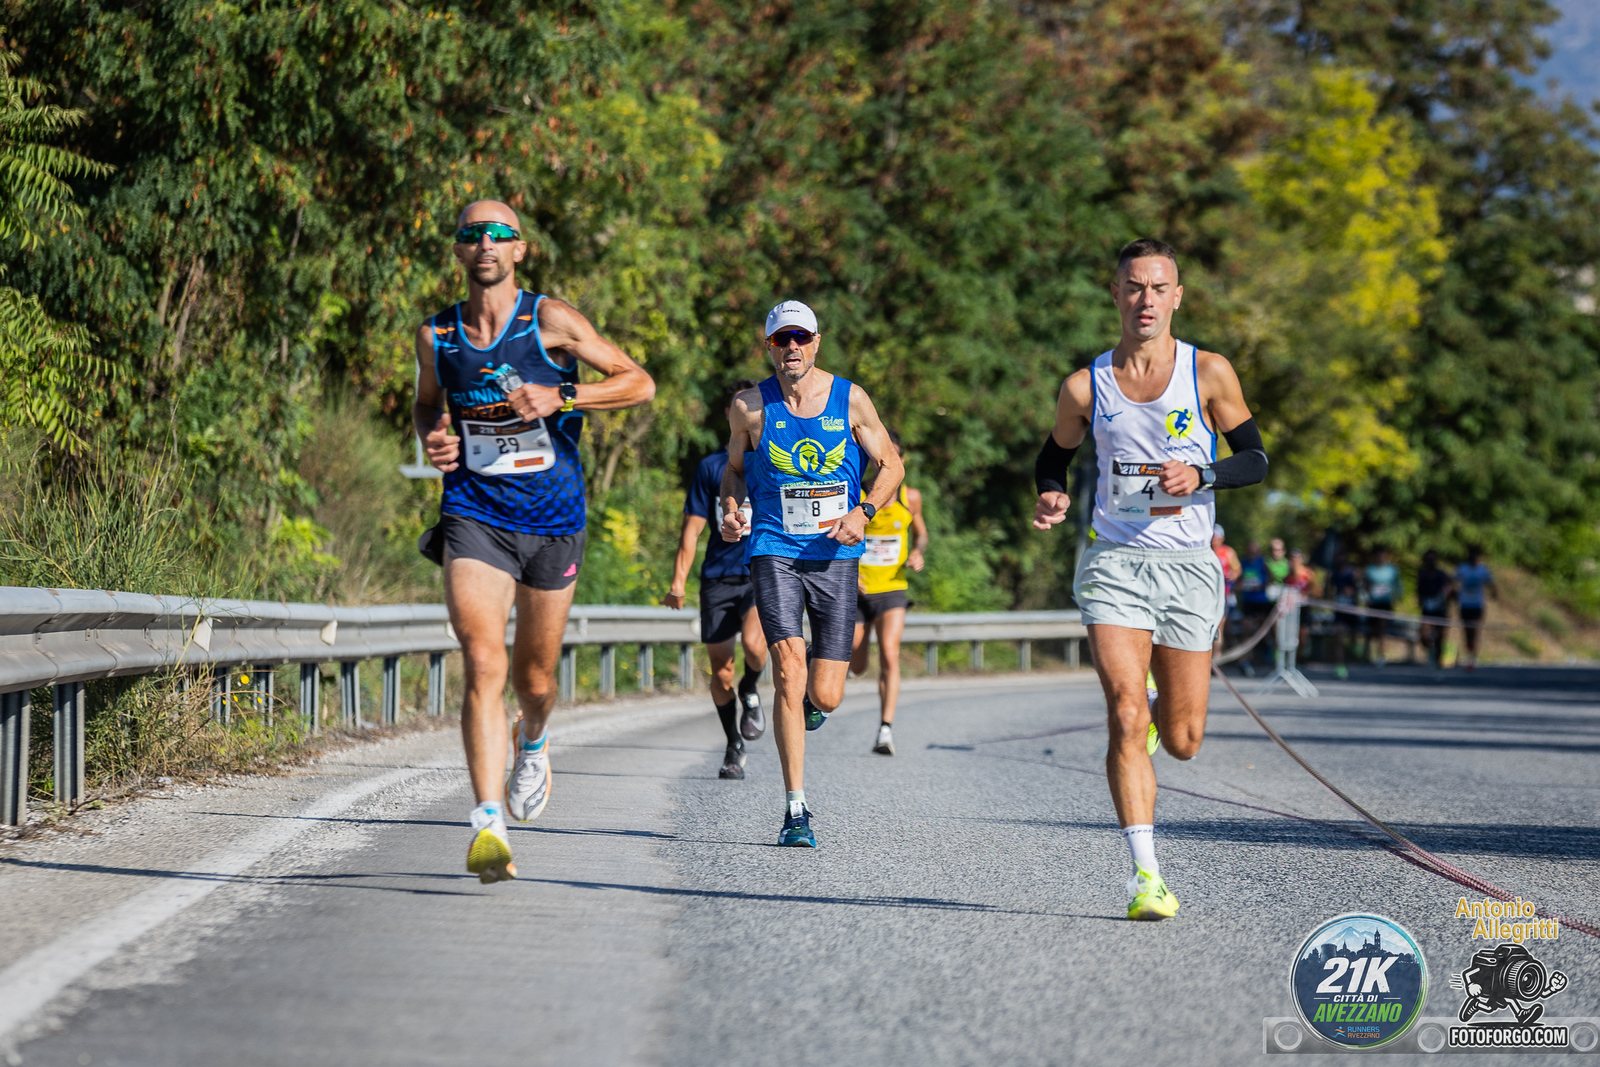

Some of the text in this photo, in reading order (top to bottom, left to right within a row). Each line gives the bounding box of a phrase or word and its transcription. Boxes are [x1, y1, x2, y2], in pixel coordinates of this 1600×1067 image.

[496, 437, 519, 454] 29
[1120, 464, 1141, 475] 21K
[795, 489, 810, 498] 21K
[1141, 480, 1154, 500] 4
[812, 501, 820, 516] 8
